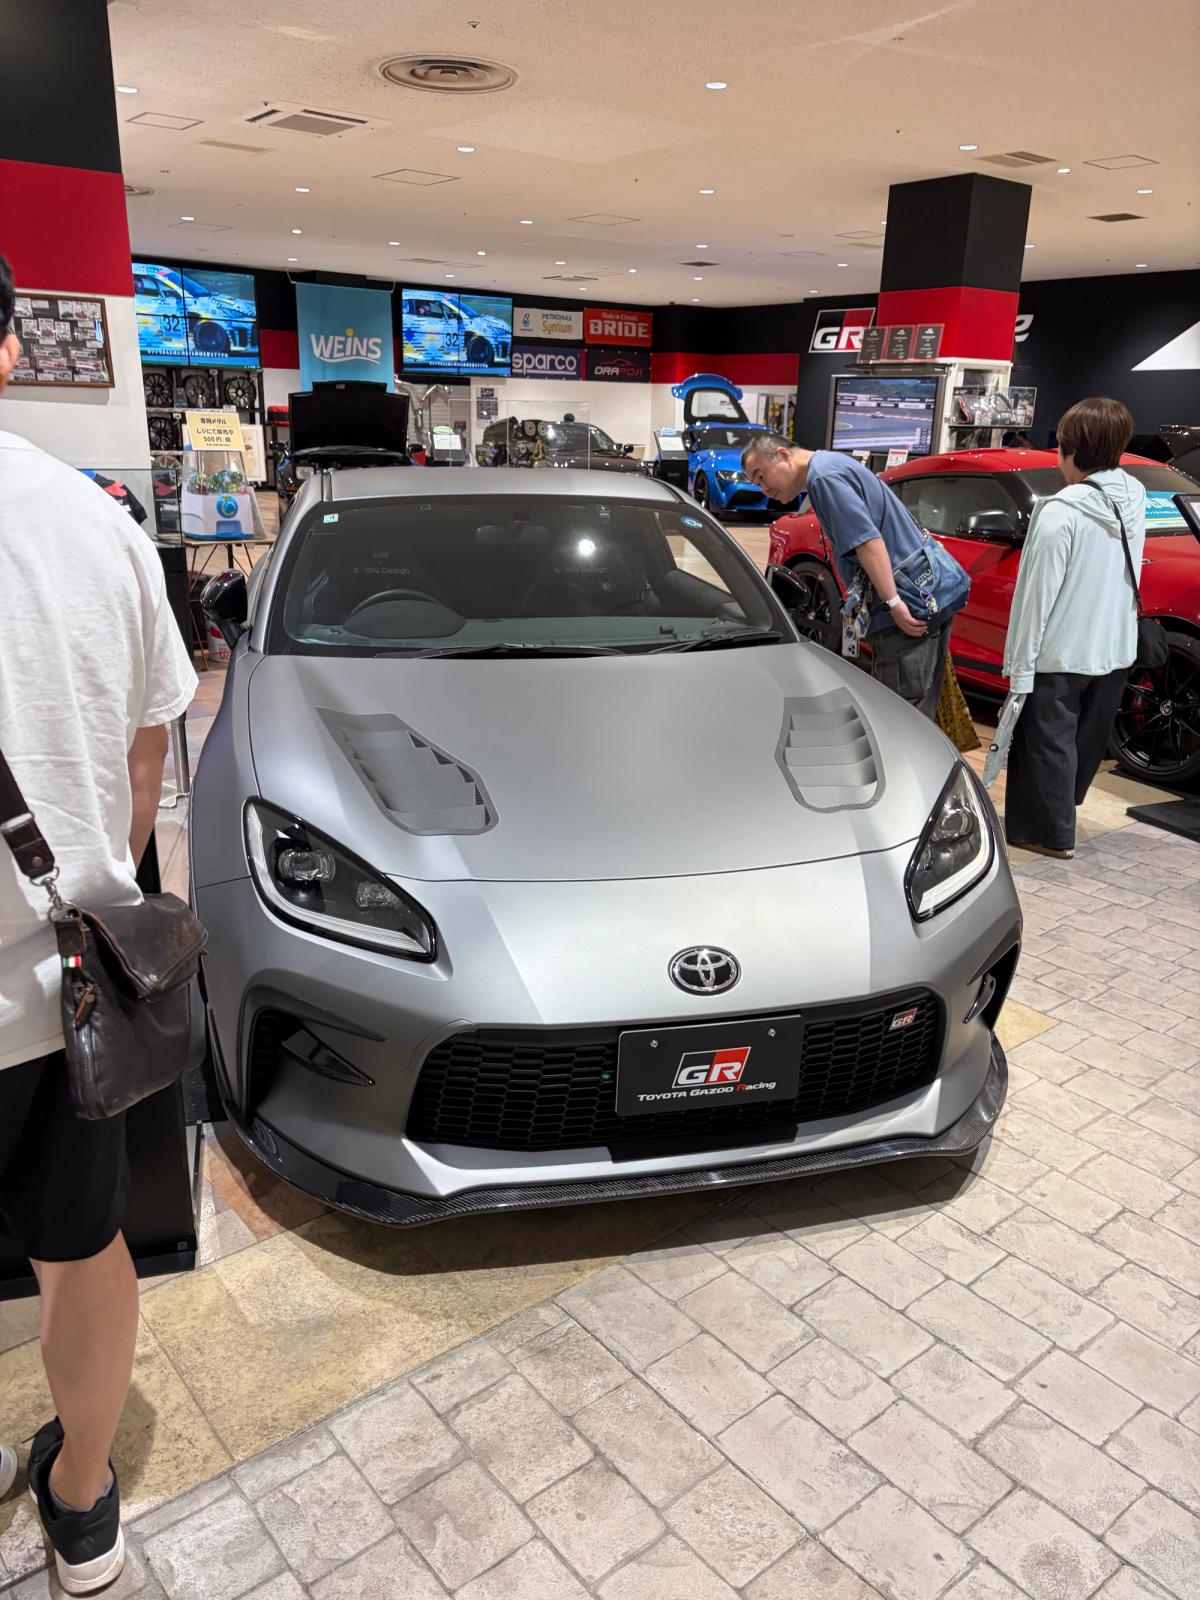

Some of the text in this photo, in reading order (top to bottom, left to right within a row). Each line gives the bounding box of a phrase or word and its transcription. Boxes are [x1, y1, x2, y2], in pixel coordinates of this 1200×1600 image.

[163, 314, 180, 331] 32
[541, 313, 572, 321] PETRONAS
[589, 319, 649, 338] BRIDE
[813, 326, 864, 349] GR
[445, 332, 459, 347] 32
[512, 352, 577, 375] sparco
[677, 1061, 742, 1085] GR
[637, 1081, 777, 1102] TOYOTA GAZOO Racing
